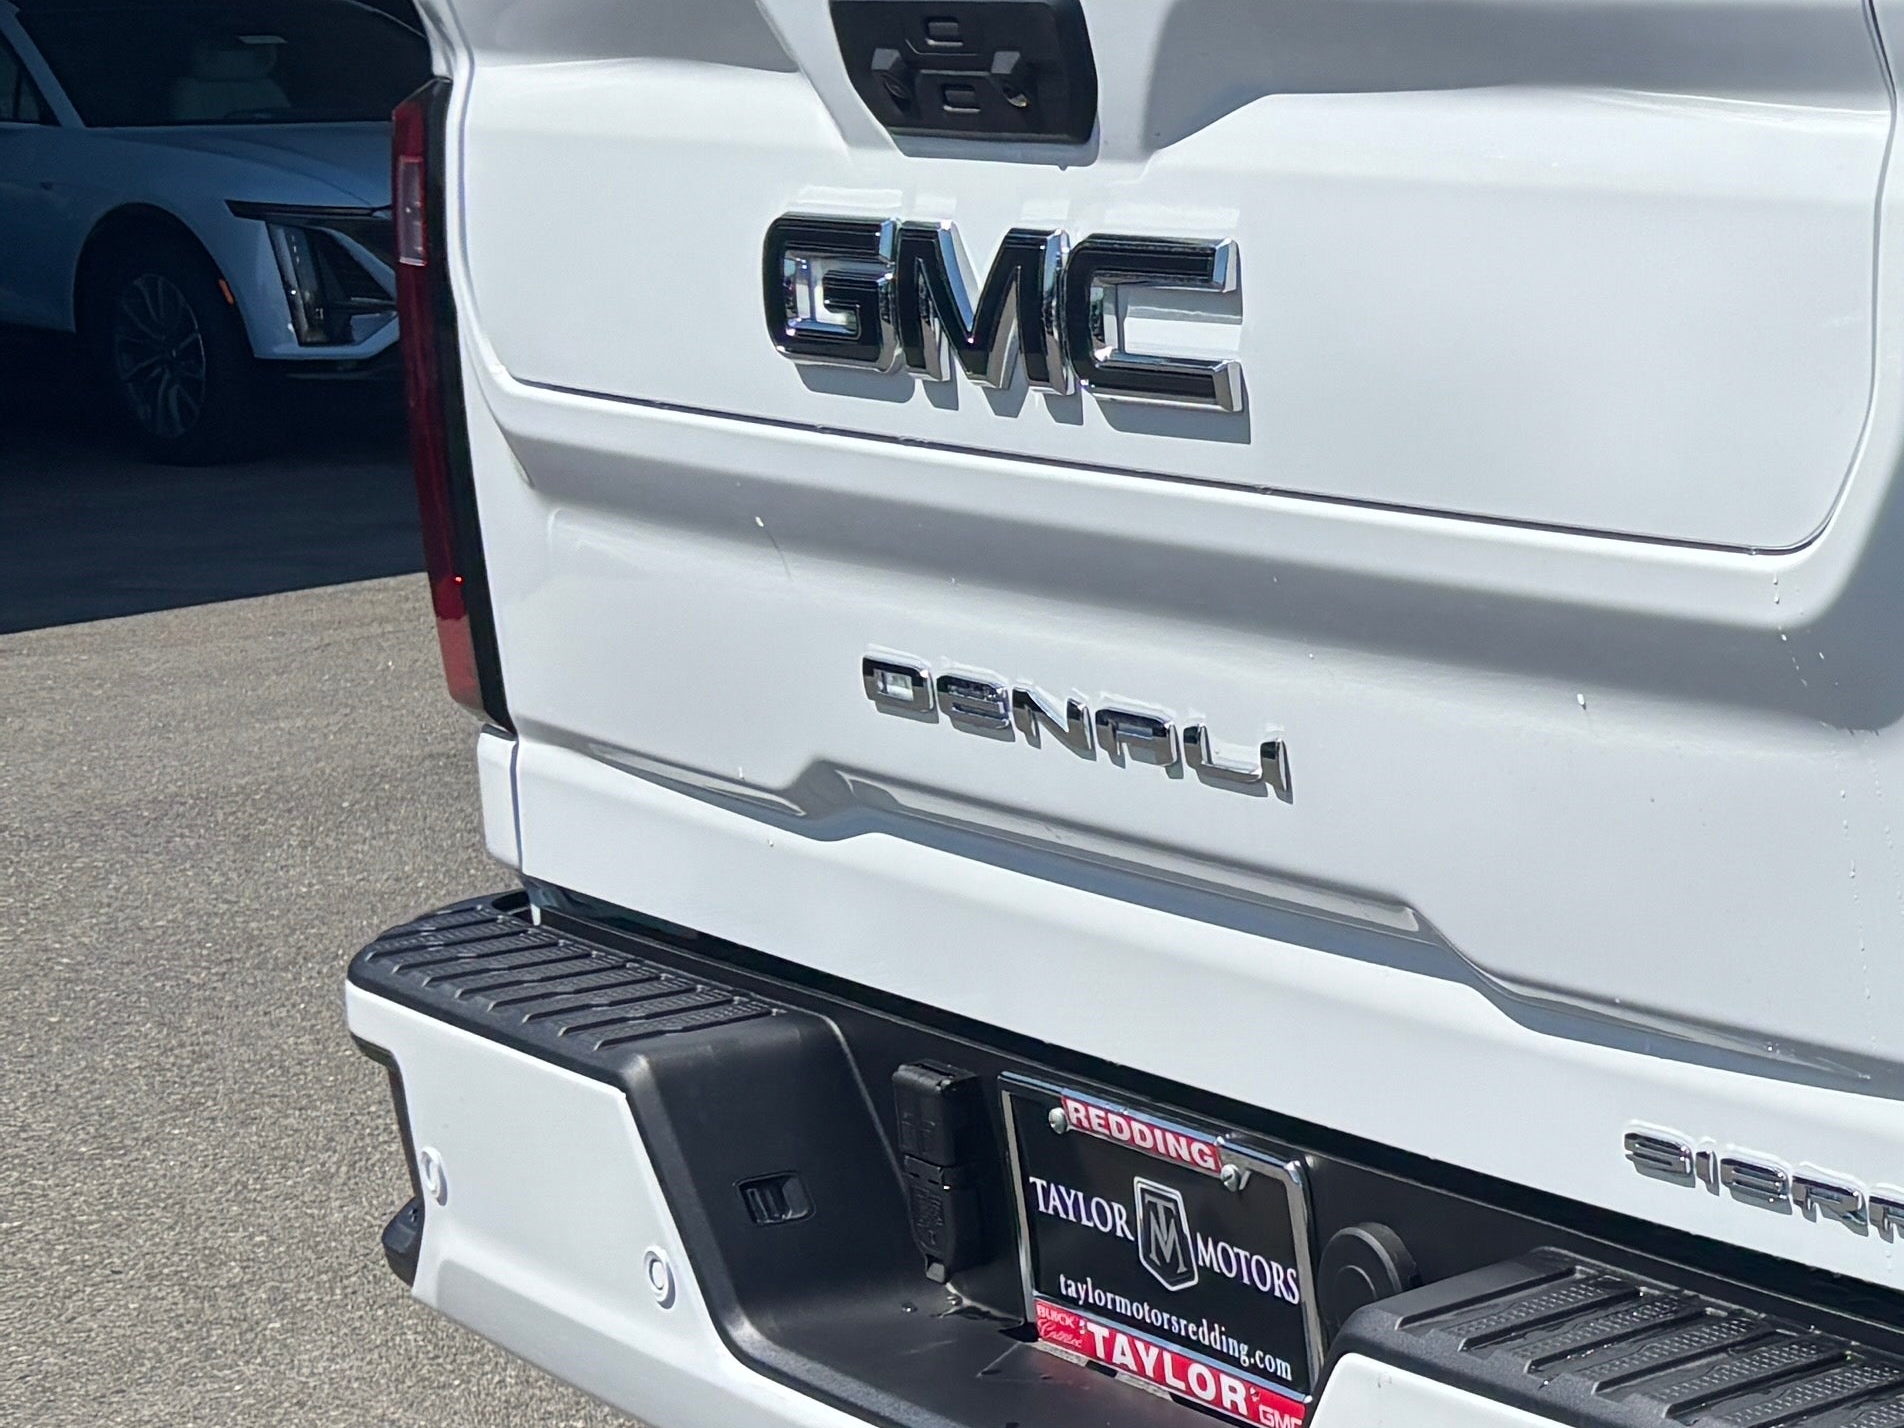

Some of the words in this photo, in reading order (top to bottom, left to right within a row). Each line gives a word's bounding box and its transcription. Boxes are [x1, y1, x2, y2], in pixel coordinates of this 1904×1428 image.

[763, 211, 1243, 413] GMC
[862, 654, 1293, 801] DENALI
[1065, 1098, 1217, 1172] REDDING
[1029, 1176, 1135, 1242] TAYLOR
[1196, 1231, 1300, 1305] MOTORS
[1036, 1304, 1075, 1328] BUICK
[1060, 1273, 1293, 1381] taylormotorsredding.com
[1086, 1323, 1249, 1416] TAYLOR
